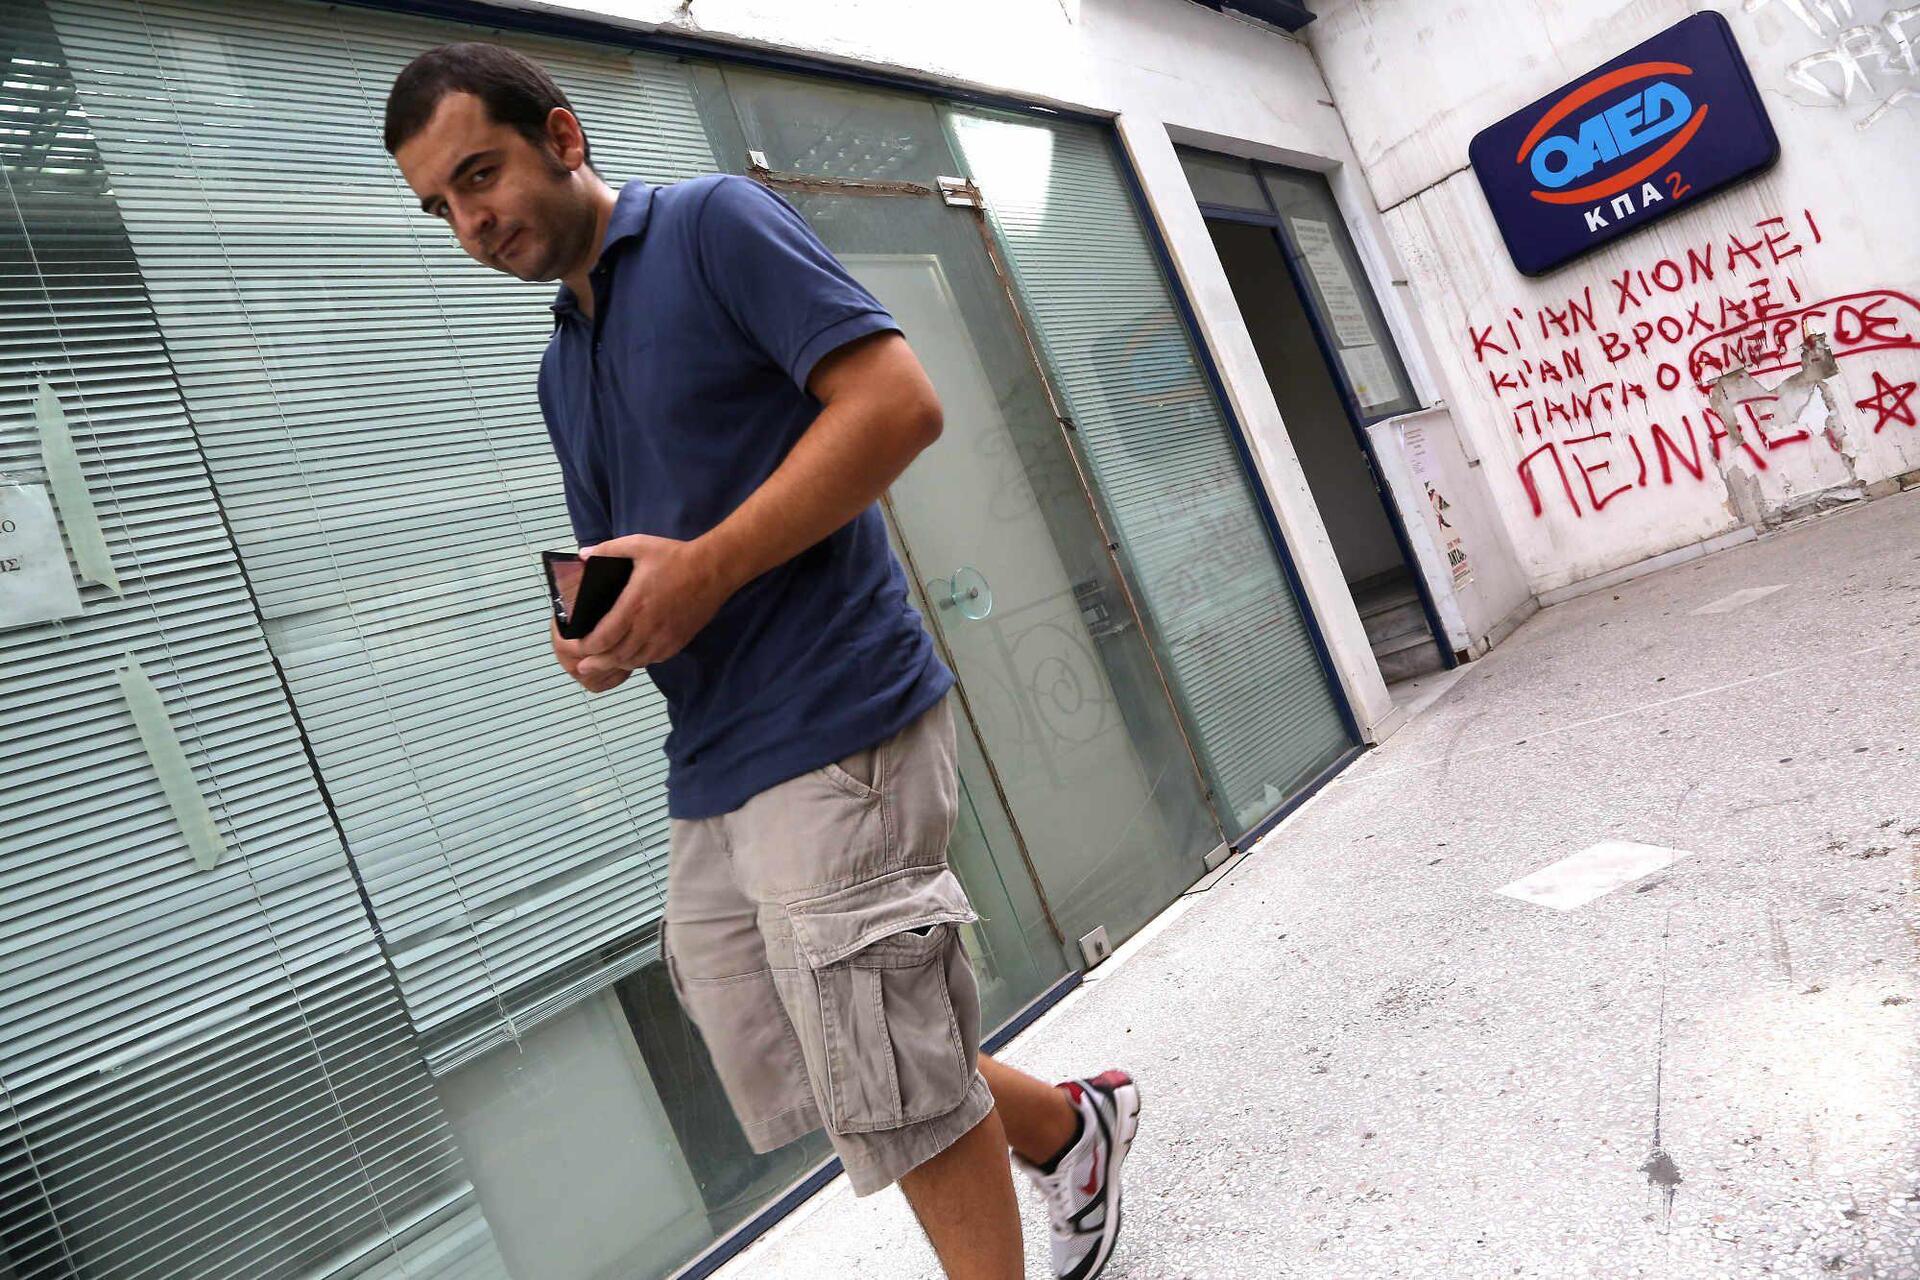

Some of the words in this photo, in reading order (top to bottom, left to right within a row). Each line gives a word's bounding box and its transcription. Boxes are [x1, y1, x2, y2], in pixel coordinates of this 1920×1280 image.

[1583, 181, 1664, 233] ΚΠΑ
[1665, 171, 1691, 200] 2
[1611, 208, 1822, 314] ΧΙΟΝΑΕΙ
[1599, 277, 1802, 364] ΒΡΟΧΑΕΙ
[1513, 379, 1648, 435] ΠΑΝΤΑ
[1656, 363, 1681, 391] Ο
